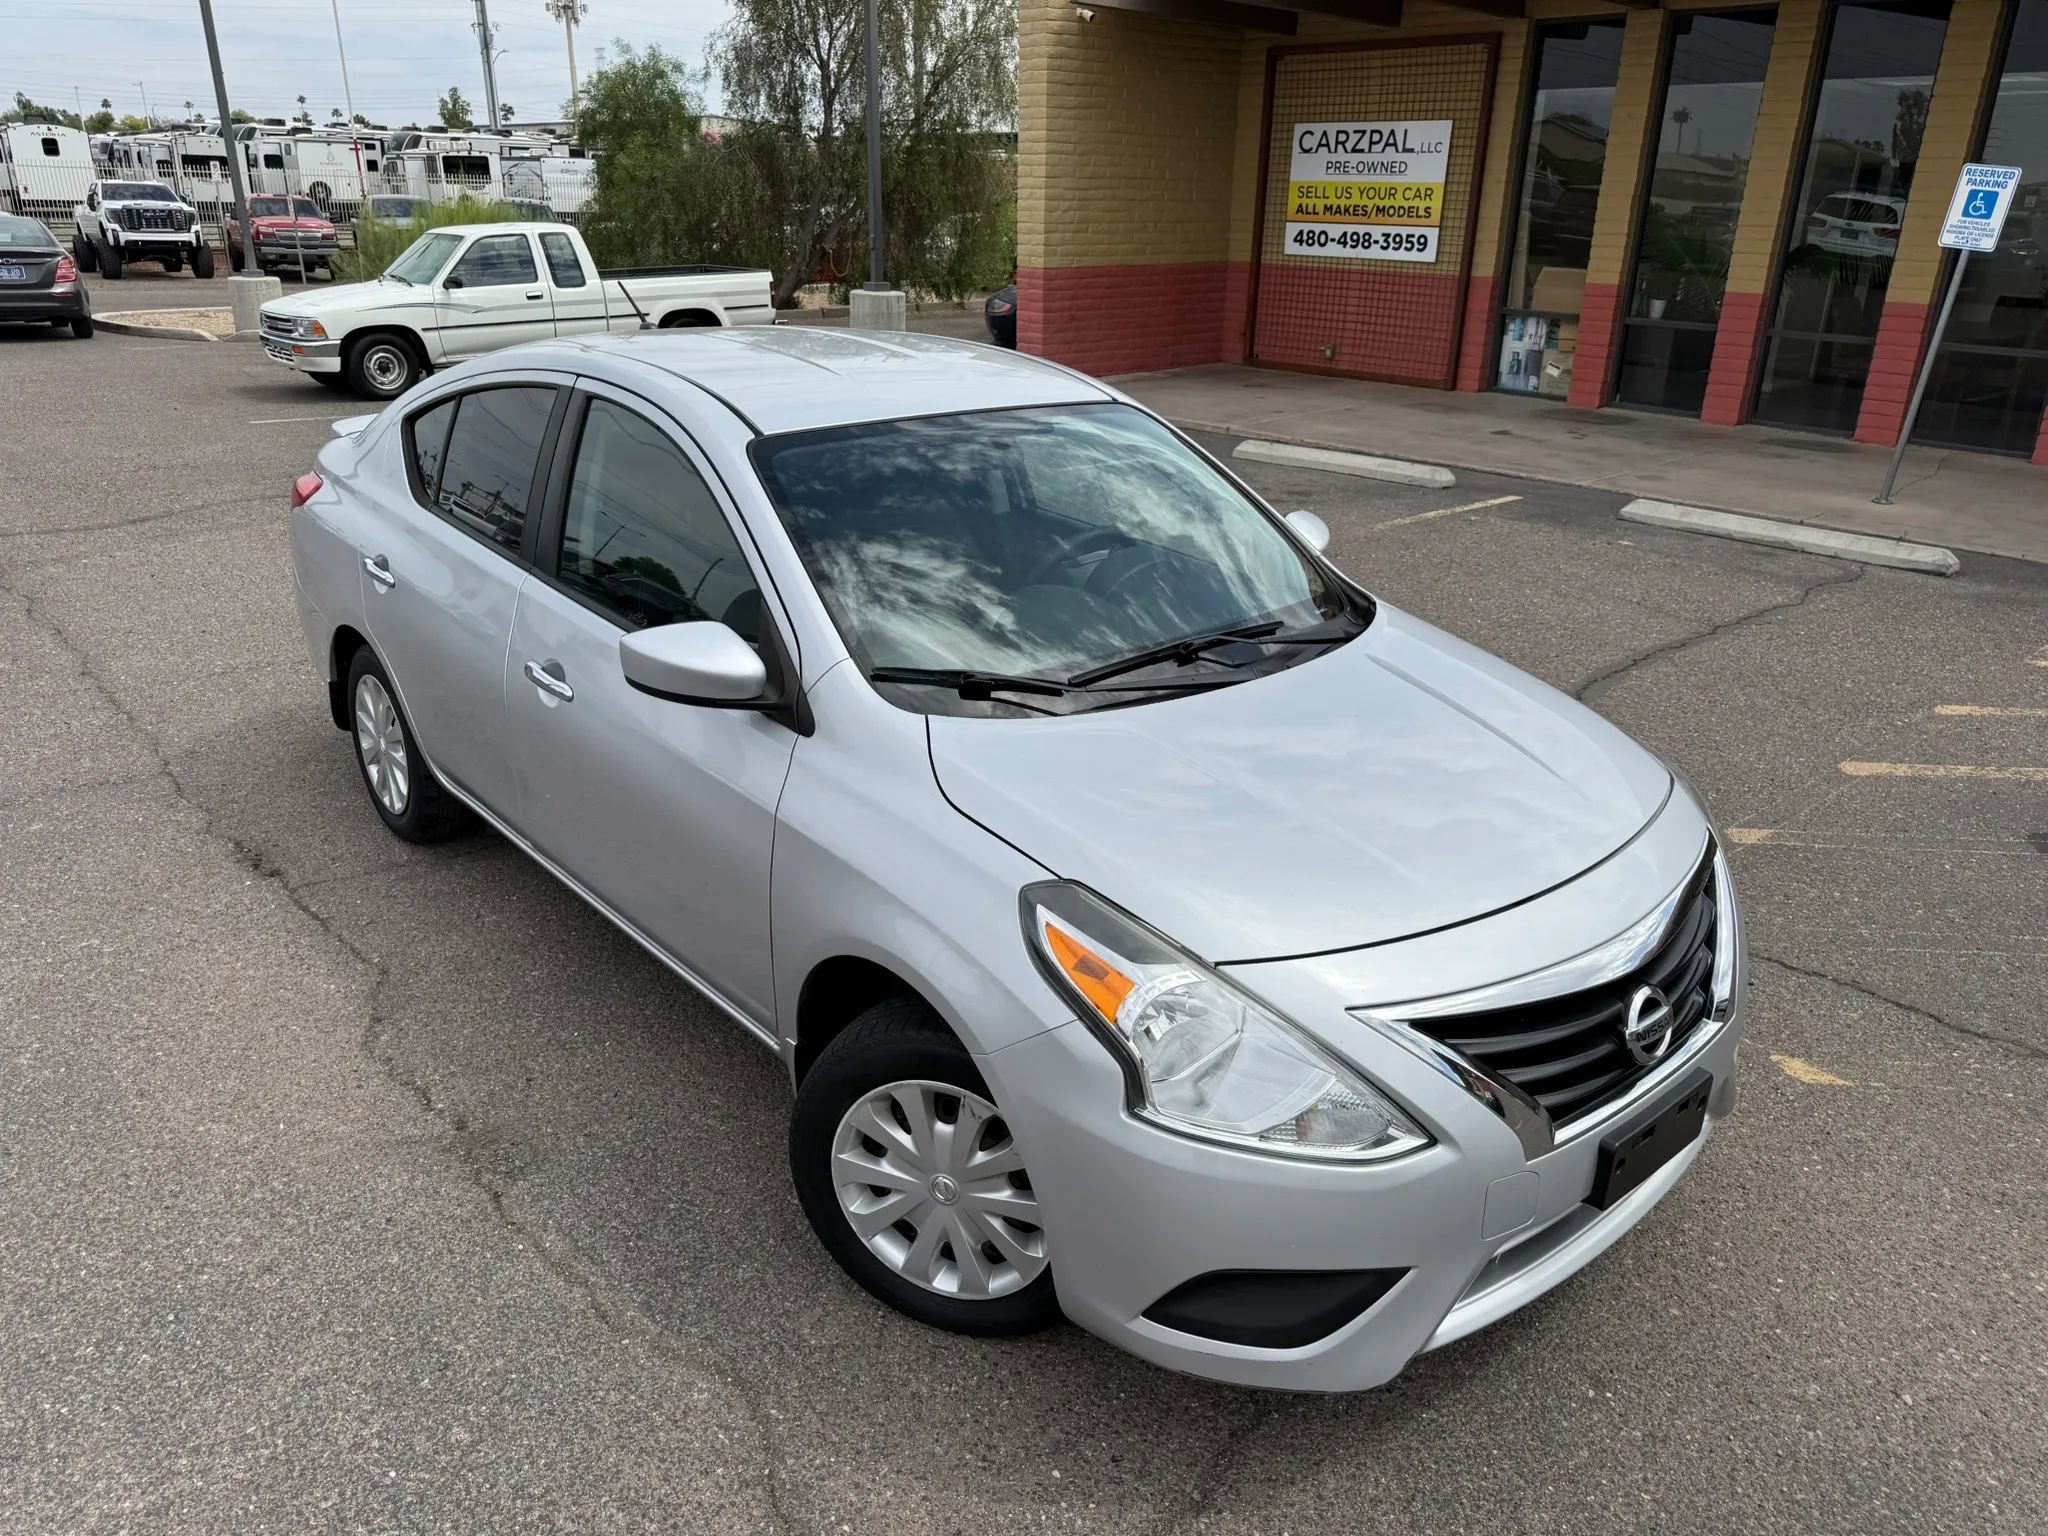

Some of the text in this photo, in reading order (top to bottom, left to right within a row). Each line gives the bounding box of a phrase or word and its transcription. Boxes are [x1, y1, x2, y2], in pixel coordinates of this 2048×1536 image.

[1325, 161, 1408, 174] PRE-OWNED
[1965, 167, 2016, 180] RESERVED
[1966, 178, 2008, 189] PARKING
[1297, 185, 1434, 202] SELL US YOUR CAR
[1295, 203, 1432, 219] ALL MAKES/MODELS
[1293, 229, 1429, 252] 480-498-3959
